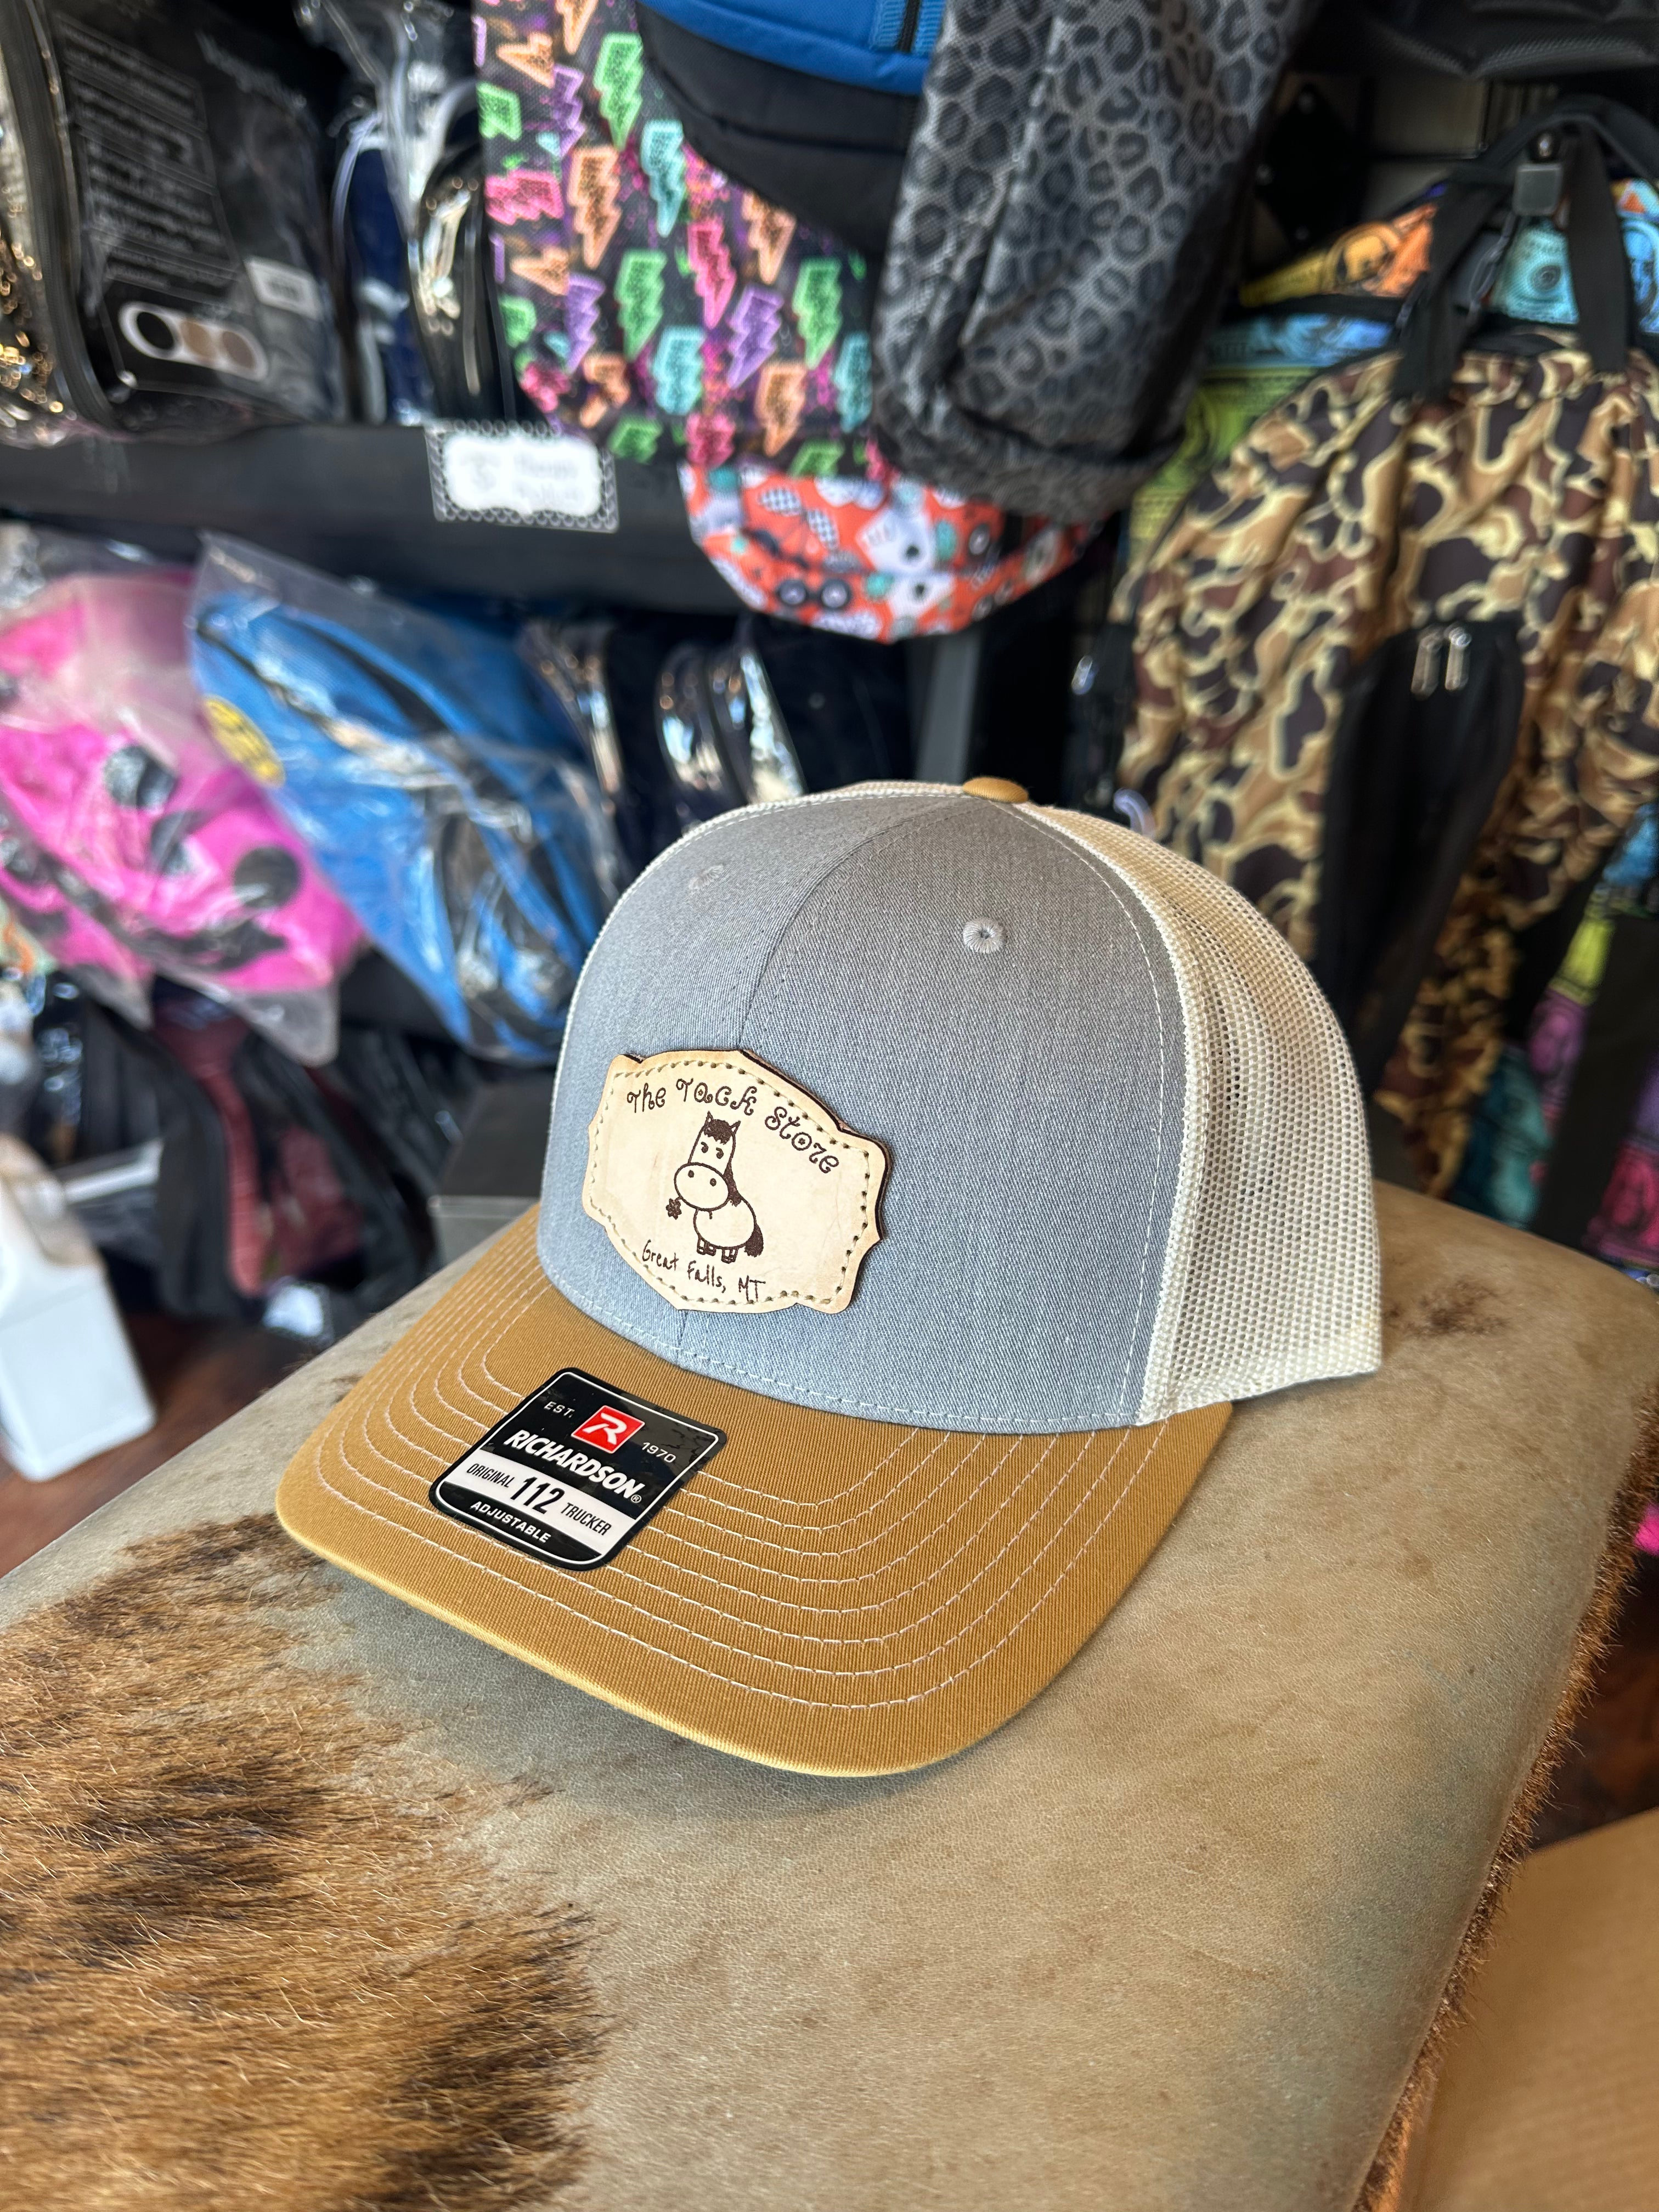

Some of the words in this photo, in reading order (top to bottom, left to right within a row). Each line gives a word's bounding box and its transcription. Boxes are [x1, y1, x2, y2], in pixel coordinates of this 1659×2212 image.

[627, 1082, 666, 1113] The
[765, 1107, 839, 1173] Store
[642, 1239, 679, 1271] Great
[687, 1260, 726, 1293] Falls,
[738, 1275, 766, 1302] MT
[544, 1401, 575, 1419] EST.
[641, 1441, 676, 1464] 1970
[466, 1463, 514, 1488] ORIGINAL
[510, 1476, 566, 1515] 112
[560, 1502, 612, 1536] TRUCKER
[470, 1500, 551, 1544] ADJUSTABLE
